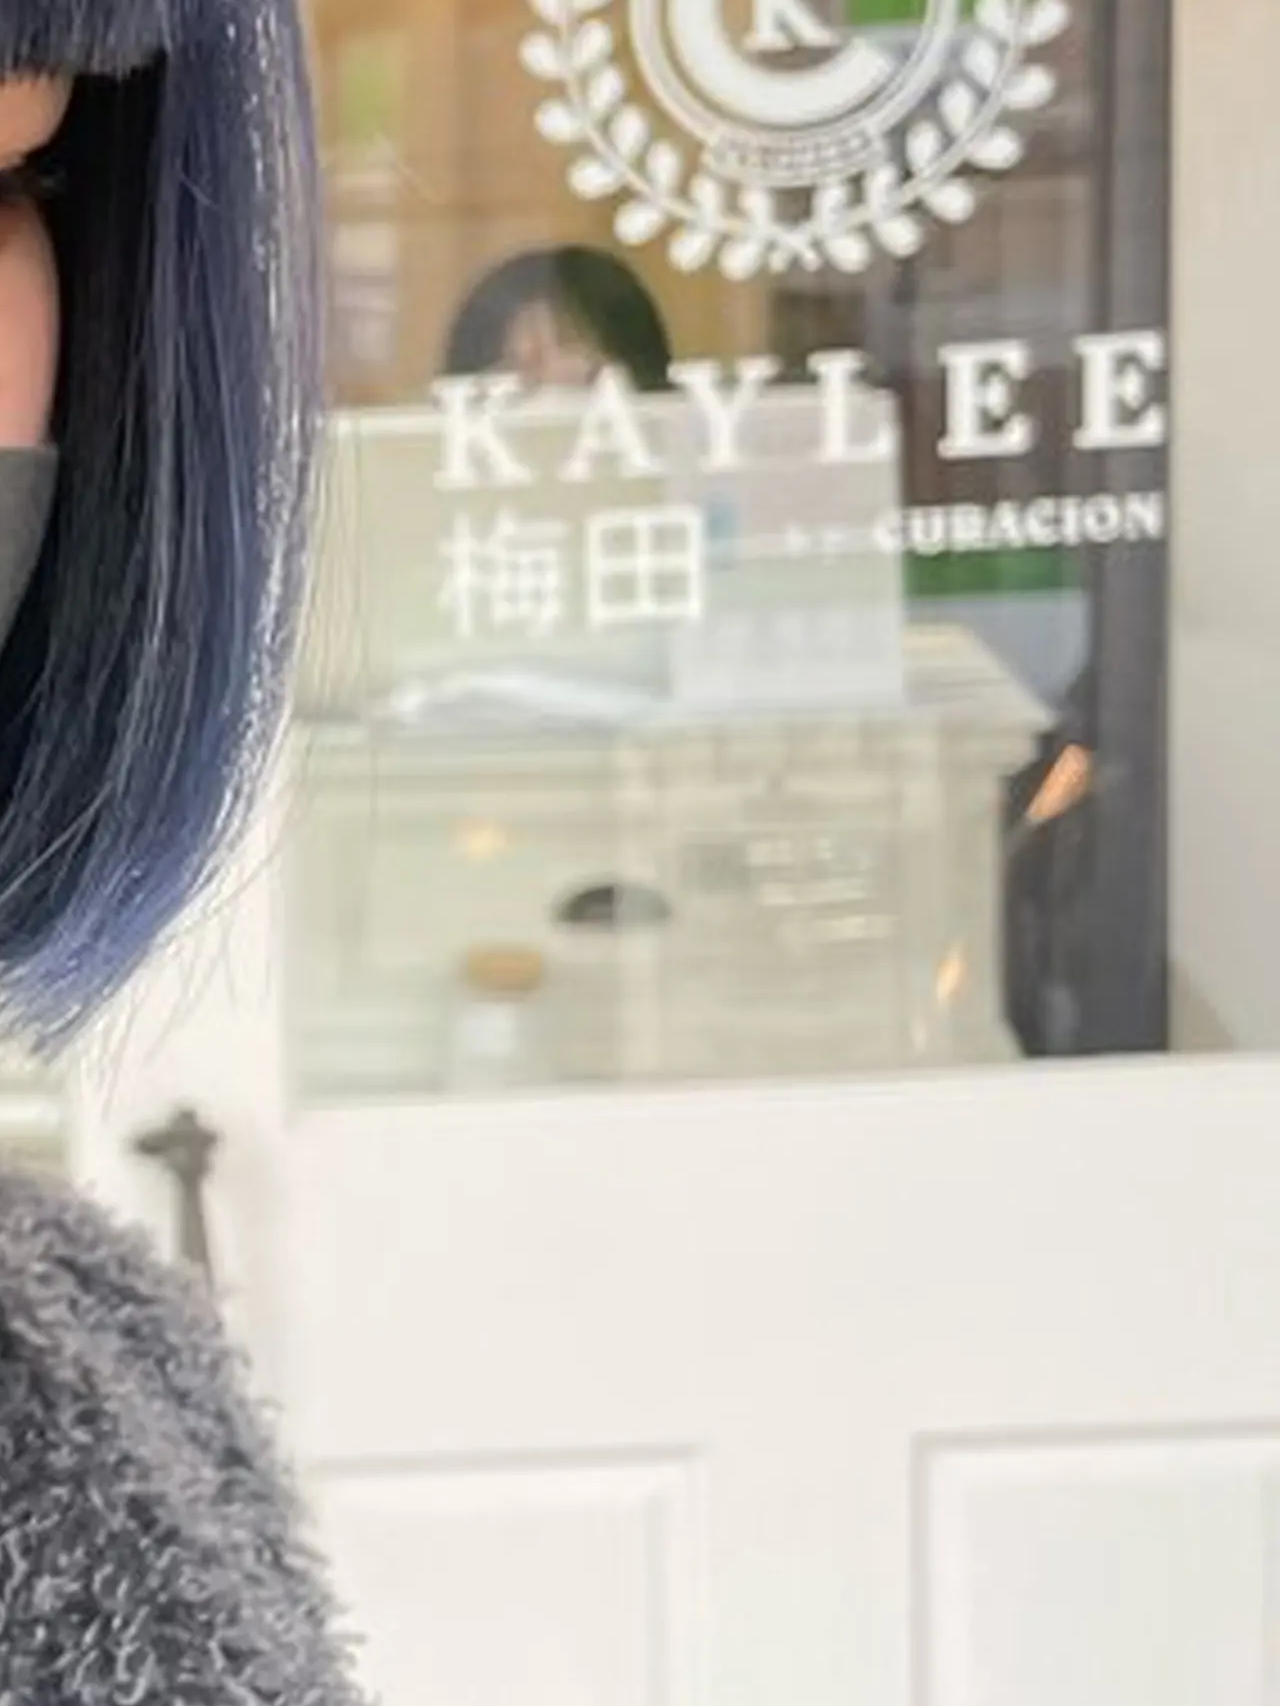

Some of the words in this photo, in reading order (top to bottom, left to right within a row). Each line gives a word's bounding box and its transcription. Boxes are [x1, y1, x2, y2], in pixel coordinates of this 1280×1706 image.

[432, 330, 1167, 489] KAYLEE
[438, 507, 705, 637] 梅田
[872, 492, 1165, 555] CURACION
